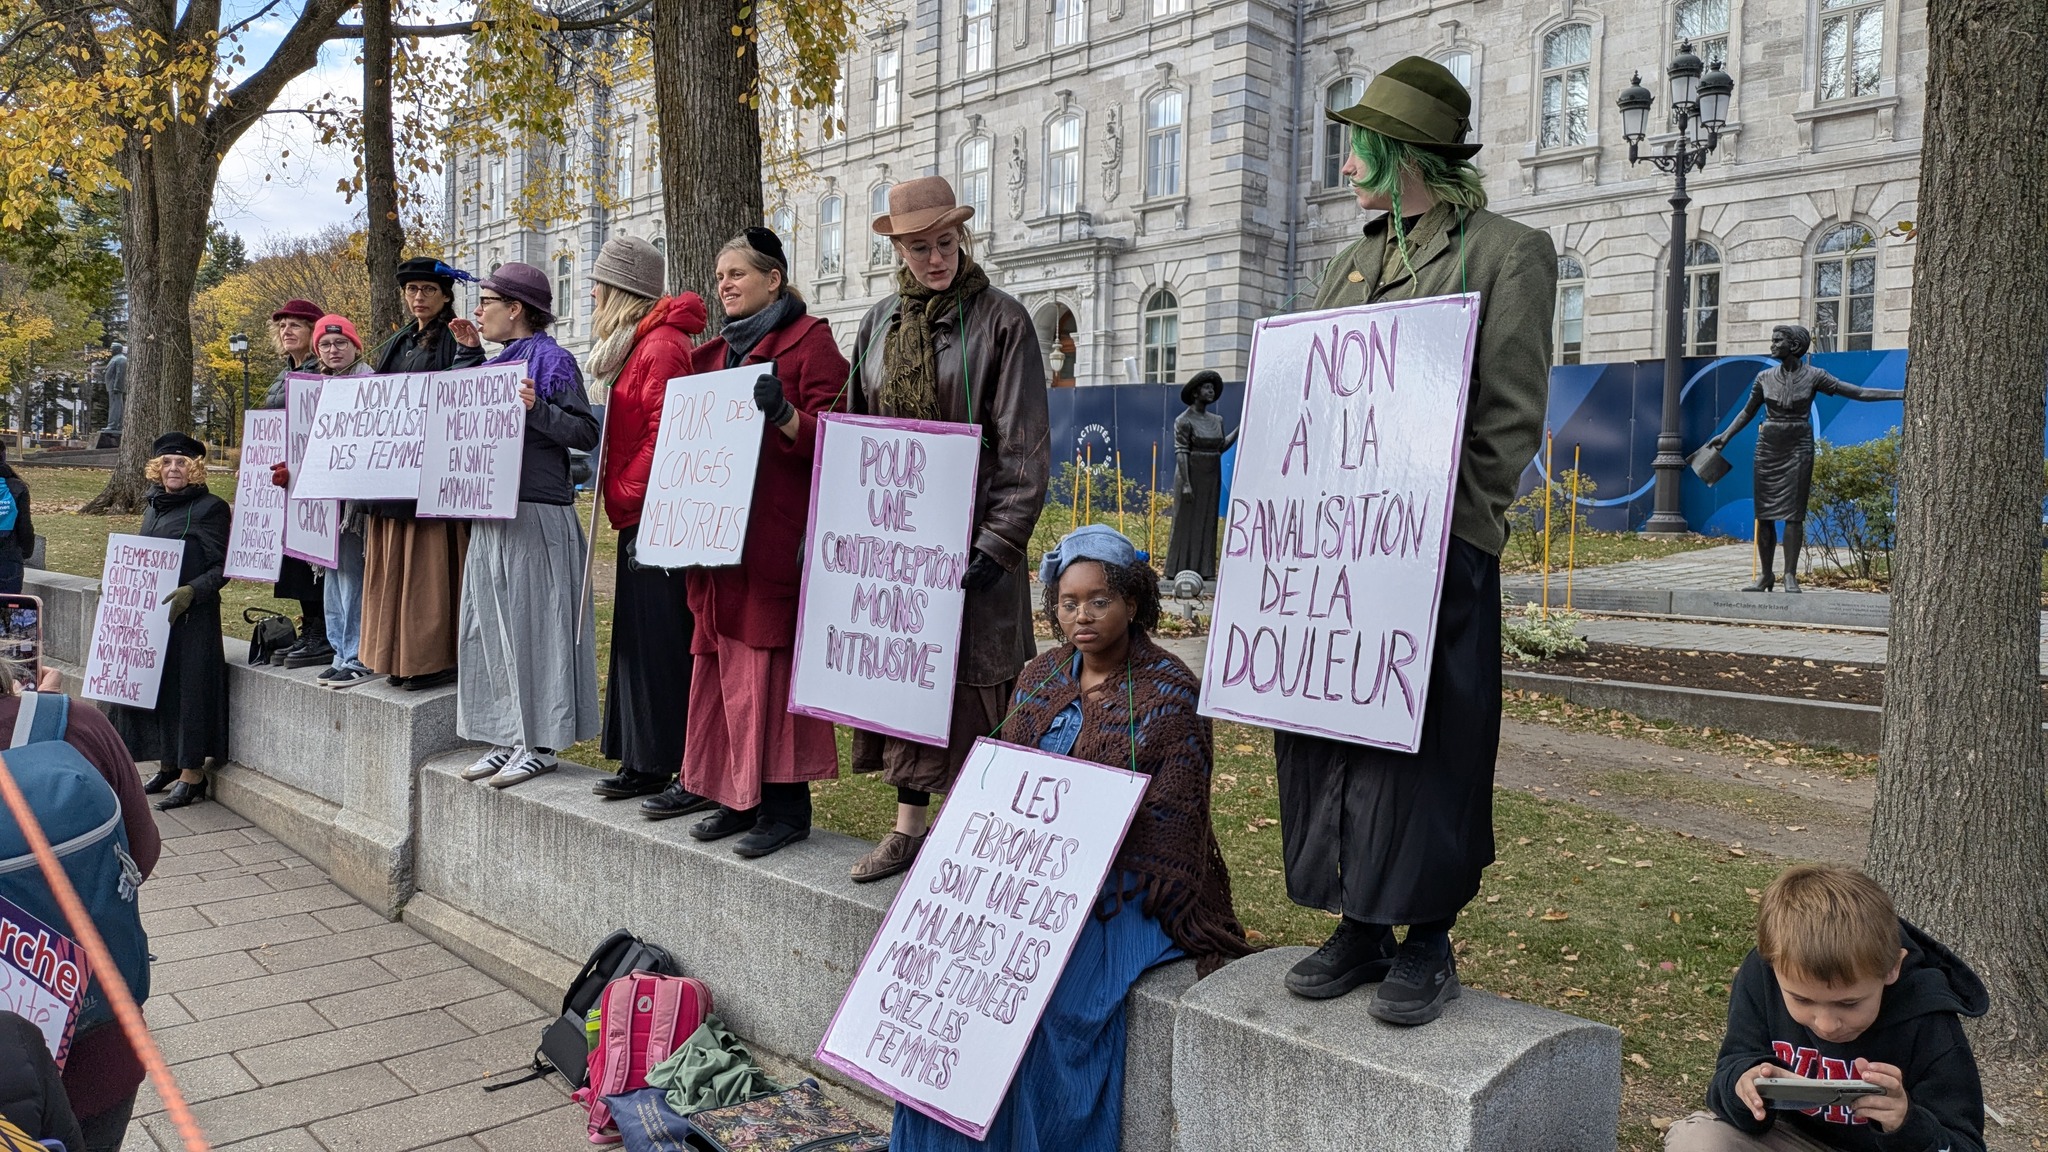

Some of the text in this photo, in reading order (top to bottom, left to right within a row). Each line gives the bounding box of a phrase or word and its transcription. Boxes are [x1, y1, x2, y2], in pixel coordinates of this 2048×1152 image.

[1304, 315, 1398, 400] NON
[355, 379, 393, 410] NON
[419, 376, 428, 407] L
[436, 380, 457, 414] POUR
[458, 379, 473, 407] DES
[314, 407, 428, 440] SURMÉDICALISA
[446, 404, 521, 441] MIEUX FORMÉS
[665, 391, 755, 447] POUR DES
[1281, 403, 1379, 476] À LA
[242, 471, 253, 487] EN
[329, 439, 424, 471] DES FEMME
[449, 438, 498, 474] EN SANTÉ
[658, 446, 734, 489] CONGÉS
[860, 436, 927, 493] POUR
[243, 511, 271, 529] POUR UN
[640, 498, 745, 552] MENSTRUELS
[867, 489, 918, 532] UNE
[1226, 489, 1432, 563] BANALISATION
[113, 545, 180, 570] 1 FEMME SUR 10
[139, 570, 159, 590] SON
[821, 531, 964, 592] CONTRACEPTION
[133, 610, 146, 628] DE
[143, 591, 158, 611] EN
[851, 583, 928, 634] MOINS
[1259, 563, 1353, 628] DE LA
[96, 643, 116, 663] NON
[102, 662, 128, 680] DE LA
[826, 624, 942, 689] INTRUSIVE
[1221, 622, 1419, 720] DOULEUR
[1010, 770, 1071, 824] LES
[955, 811, 1079, 880] FIBROMES
[930, 858, 1078, 933] SONT UNE DES
[877, 941, 941, 989] MOINS
[901, 898, 1051, 984] MALADIES LES
[879, 981, 969, 1043] CHEZ LES
[865, 1019, 960, 1090] FEMMES
